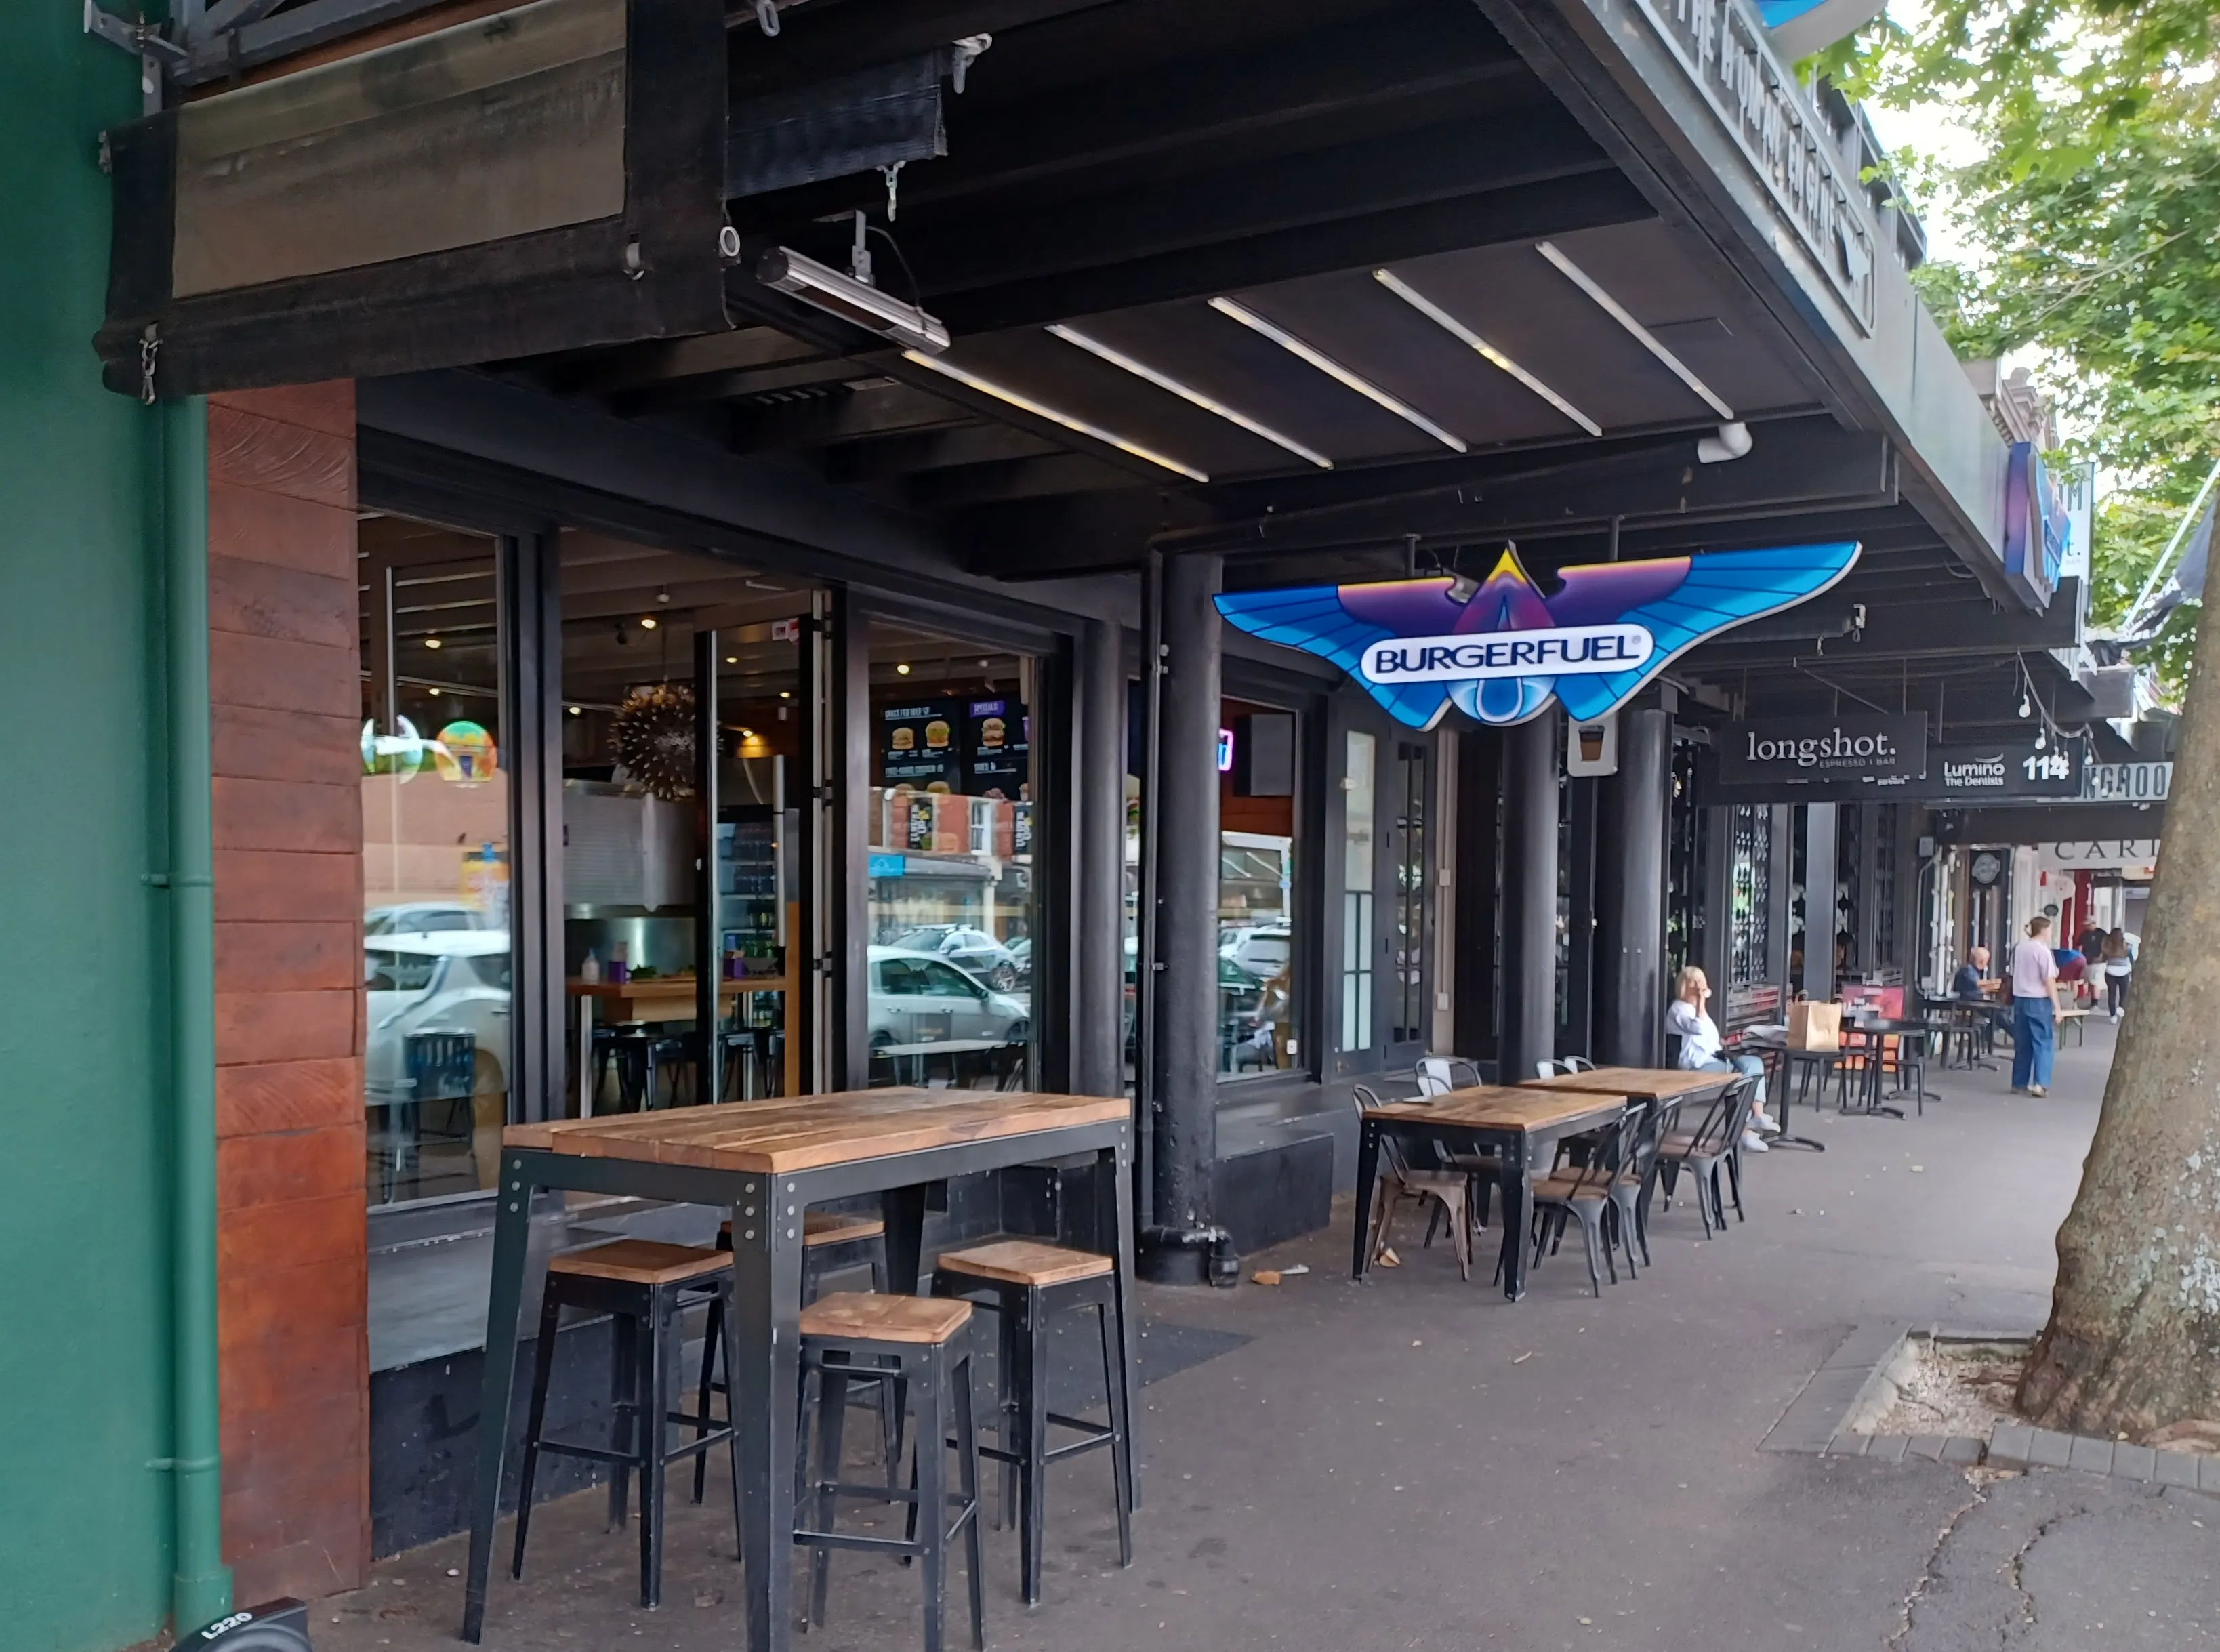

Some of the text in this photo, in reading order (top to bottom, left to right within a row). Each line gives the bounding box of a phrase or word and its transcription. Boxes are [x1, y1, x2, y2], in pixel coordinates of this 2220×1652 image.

[1788, 127, 1835, 246] ENGINE
[1375, 635, 1640, 674] BURGERFUEL
[1746, 727, 1897, 767] longshot.
[1819, 756, 1895, 768] ESPRESSO BAR
[2023, 755, 2070, 780] 114
[1944, 777, 2005, 787] The Dentists
[201, 1612, 253, 1640] L220
